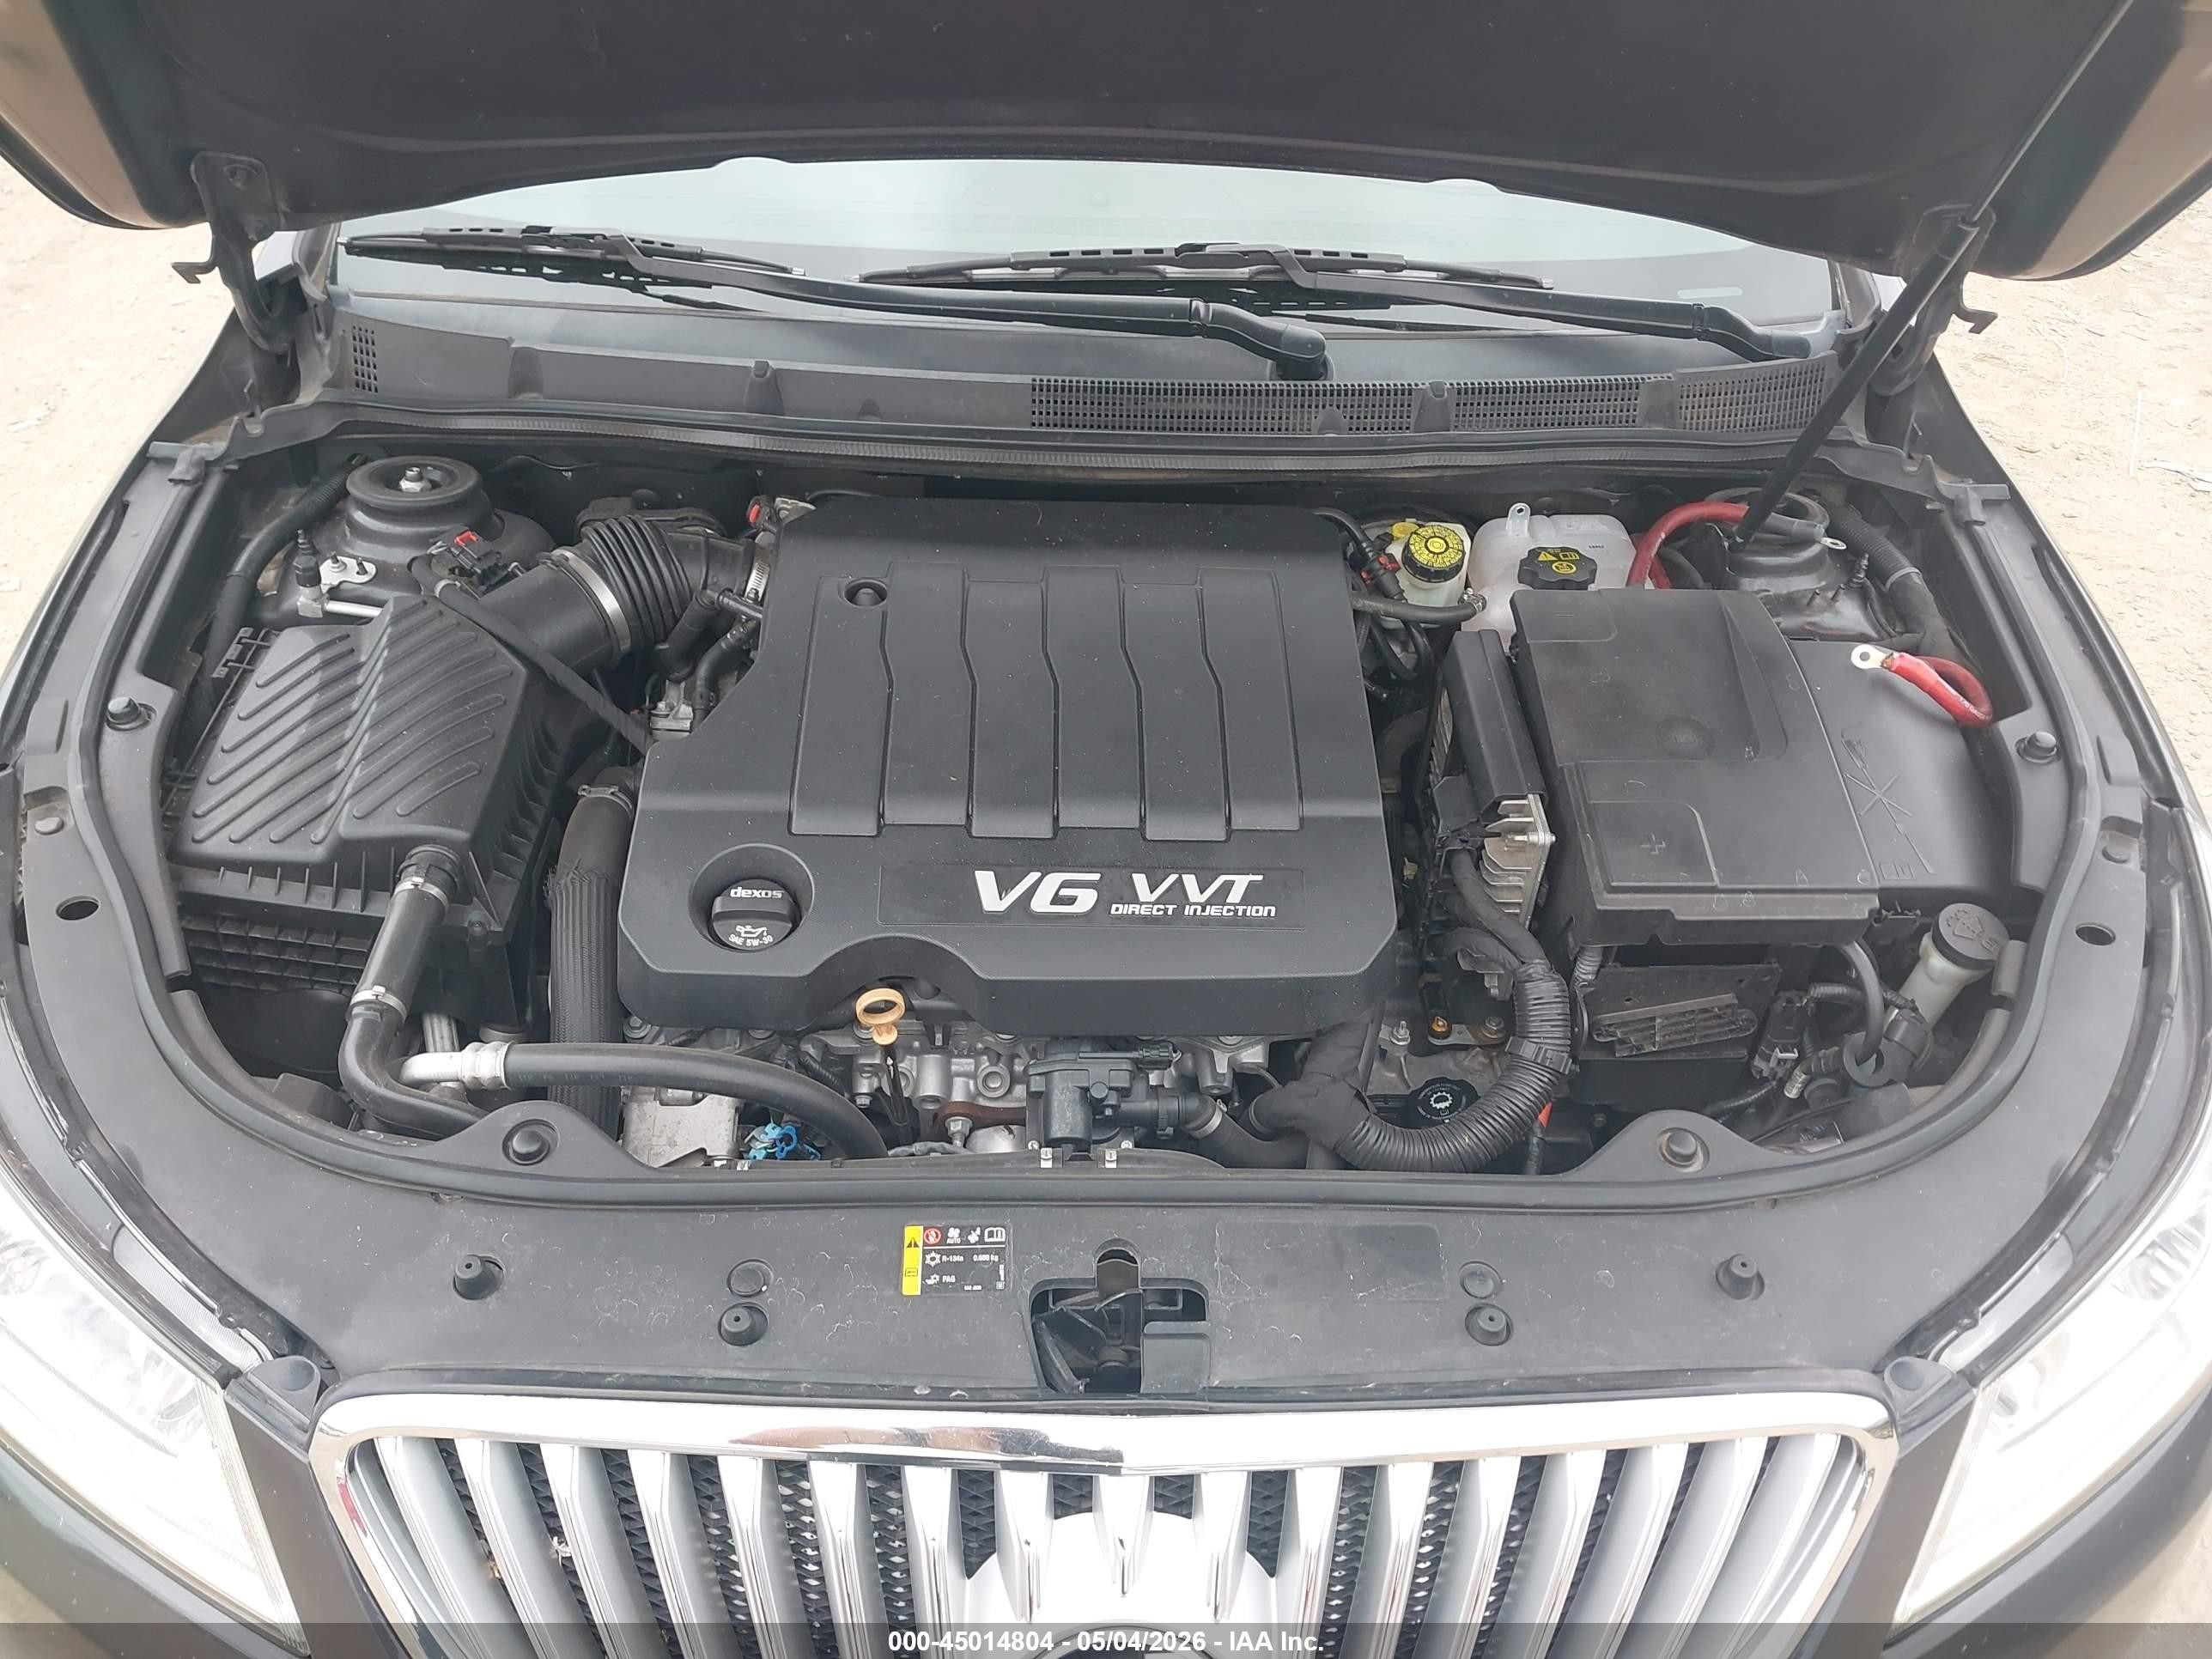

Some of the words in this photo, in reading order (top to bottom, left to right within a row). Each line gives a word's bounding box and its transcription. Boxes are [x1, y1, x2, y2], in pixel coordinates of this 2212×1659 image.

[730, 887, 784, 898] dexos
[975, 870, 1101, 914] V6
[1131, 873, 1263, 903] VVT
[1109, 903, 1177, 917] DIRECT
[1184, 904, 1276, 917] INJECTION
[728, 934, 744, 945] SAE
[746, 935, 774, 946] 5W-30
